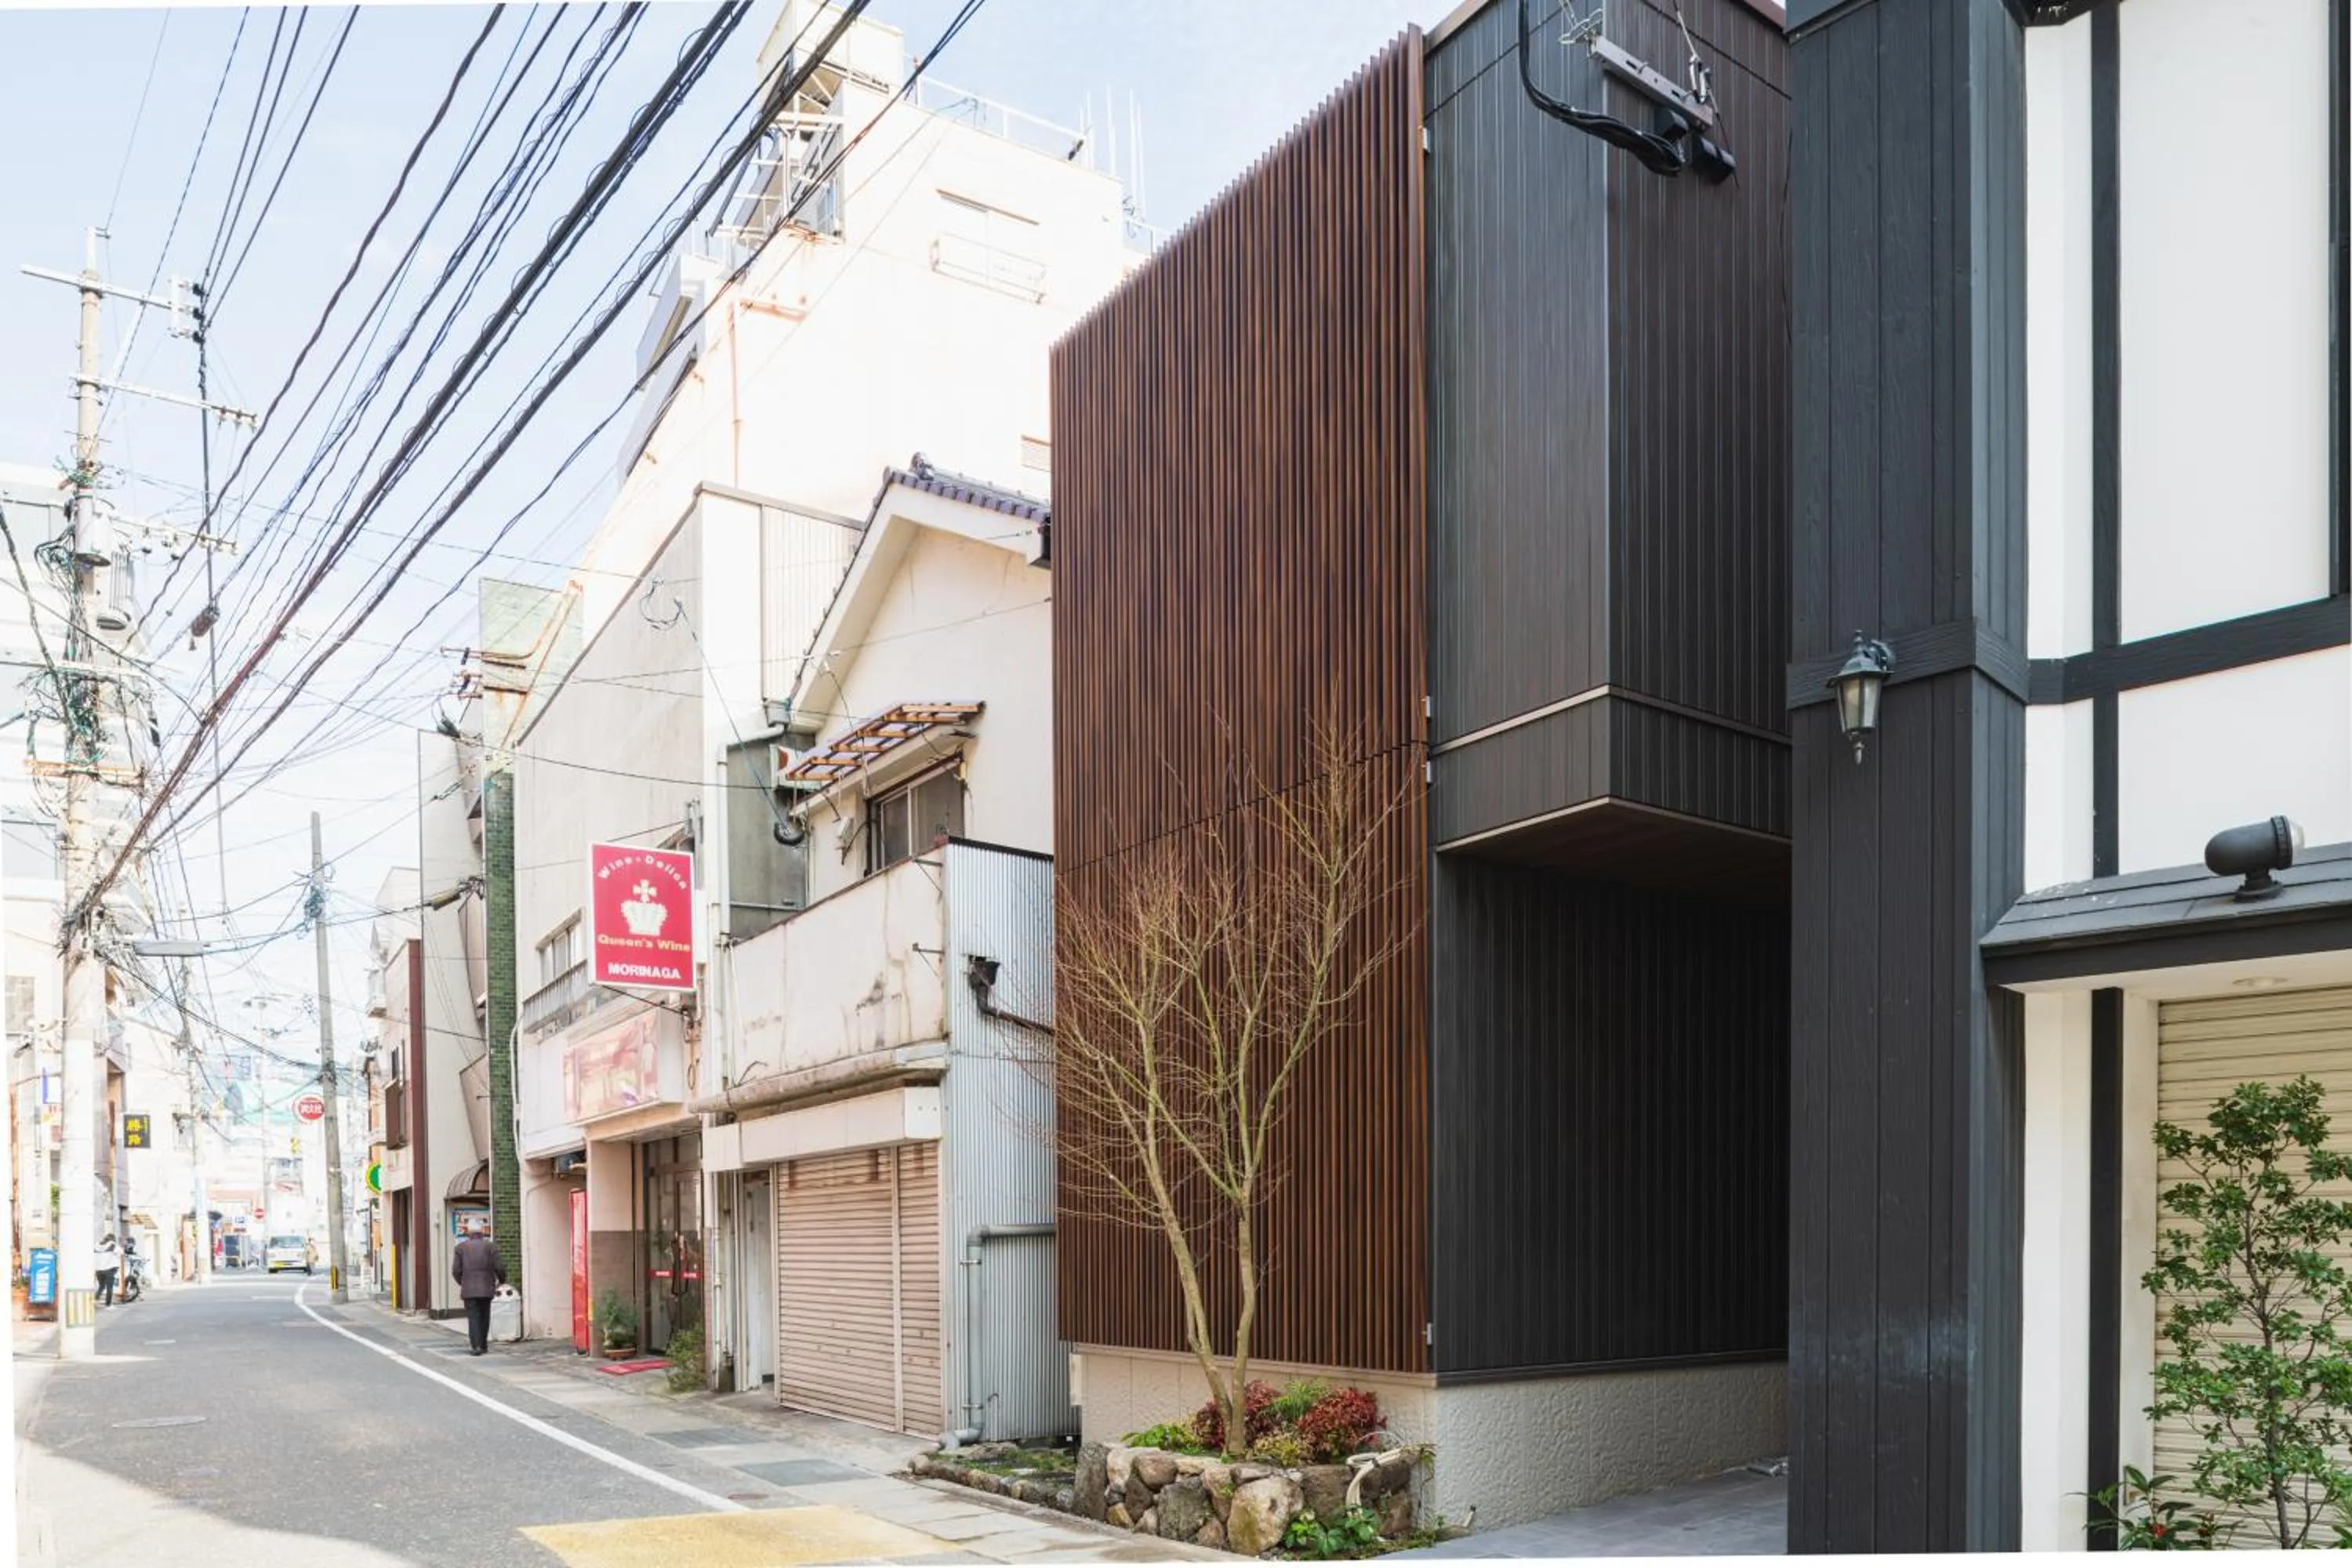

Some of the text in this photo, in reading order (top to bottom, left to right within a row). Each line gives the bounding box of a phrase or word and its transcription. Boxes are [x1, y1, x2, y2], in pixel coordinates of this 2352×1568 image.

[598, 934, 691, 953] Queen's Wine
[608, 963, 681, 979] MORINAGA
